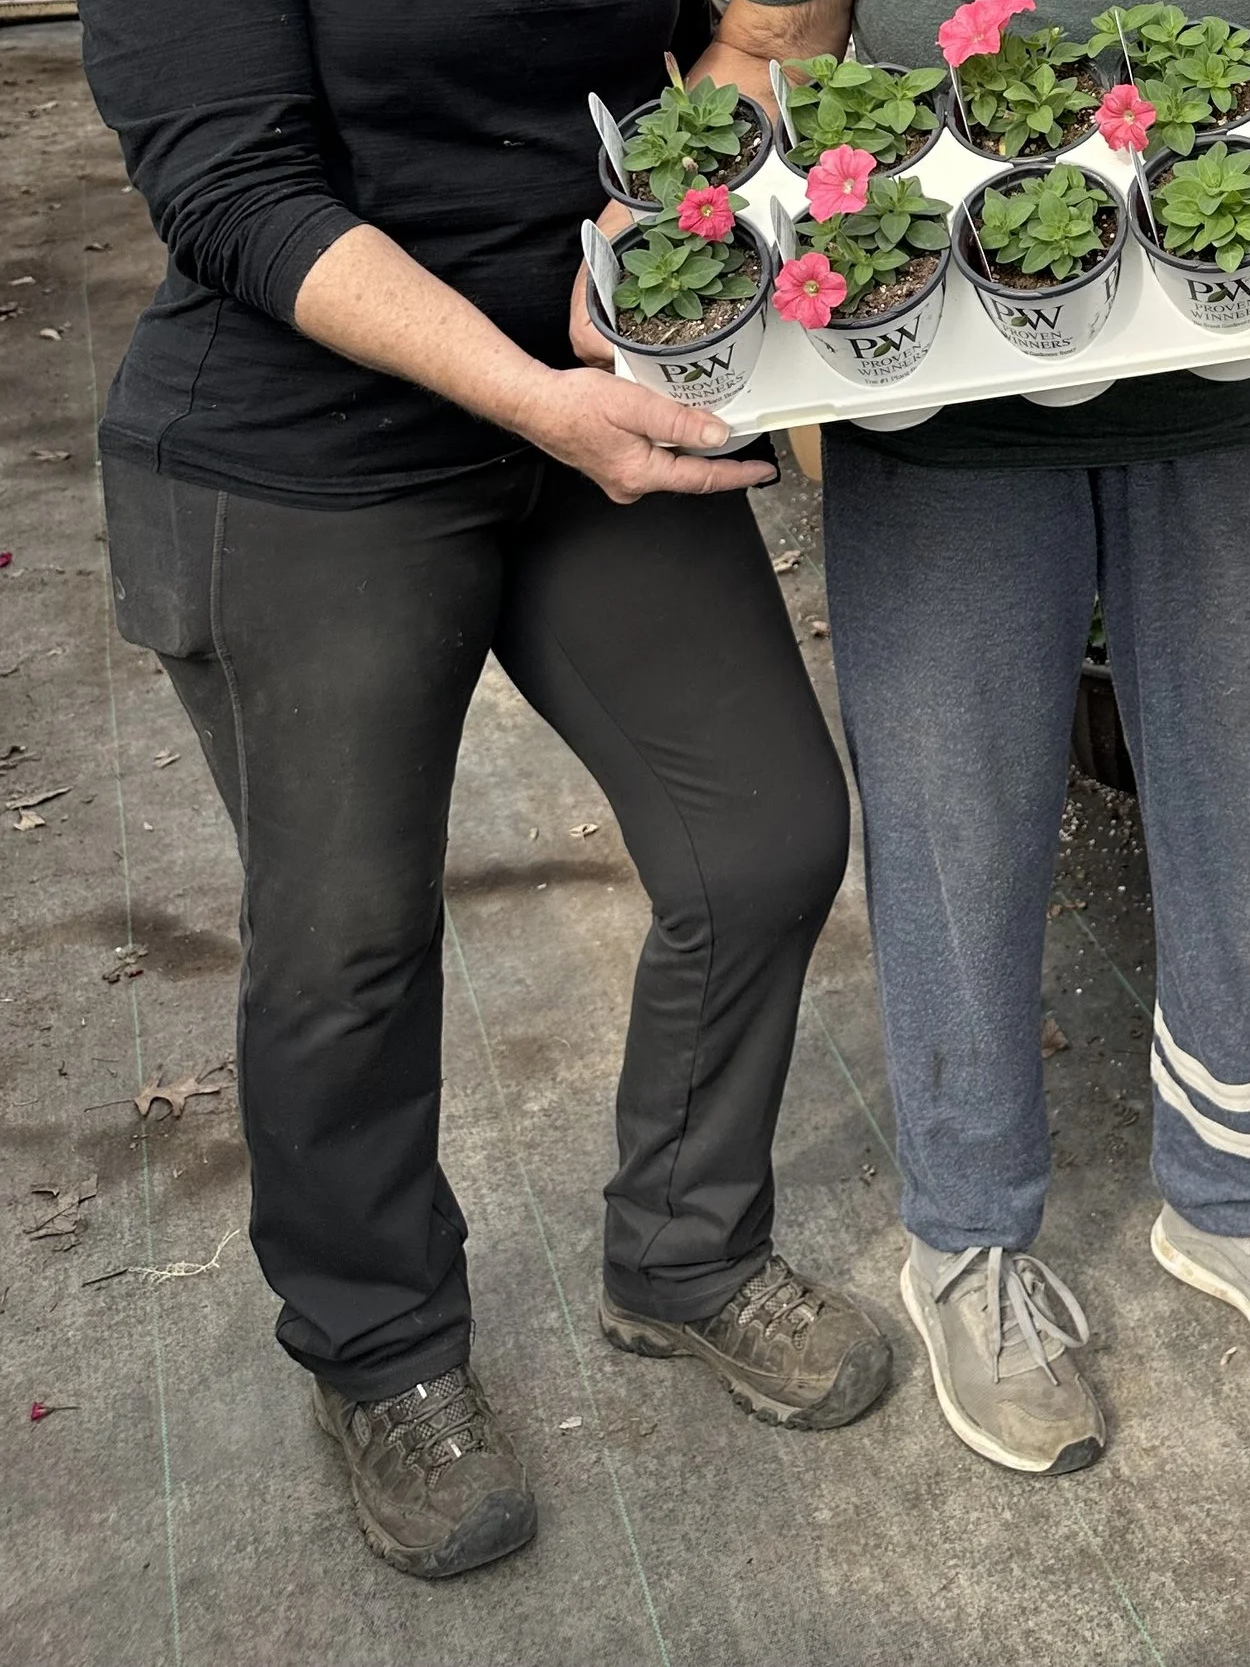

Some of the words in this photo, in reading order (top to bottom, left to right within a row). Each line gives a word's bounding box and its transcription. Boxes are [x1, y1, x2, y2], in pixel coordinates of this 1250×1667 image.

[991, 297, 1064, 331] PW
[846, 315, 921, 359] PW
[1002, 324, 1062, 341] PROVEN
[657, 341, 736, 383] PW
[857, 348, 929, 377] WINNERS
[861, 341, 921, 368] PROVEN
[669, 376, 744, 400] WINNERS
[672, 368, 736, 392] PROVEN
